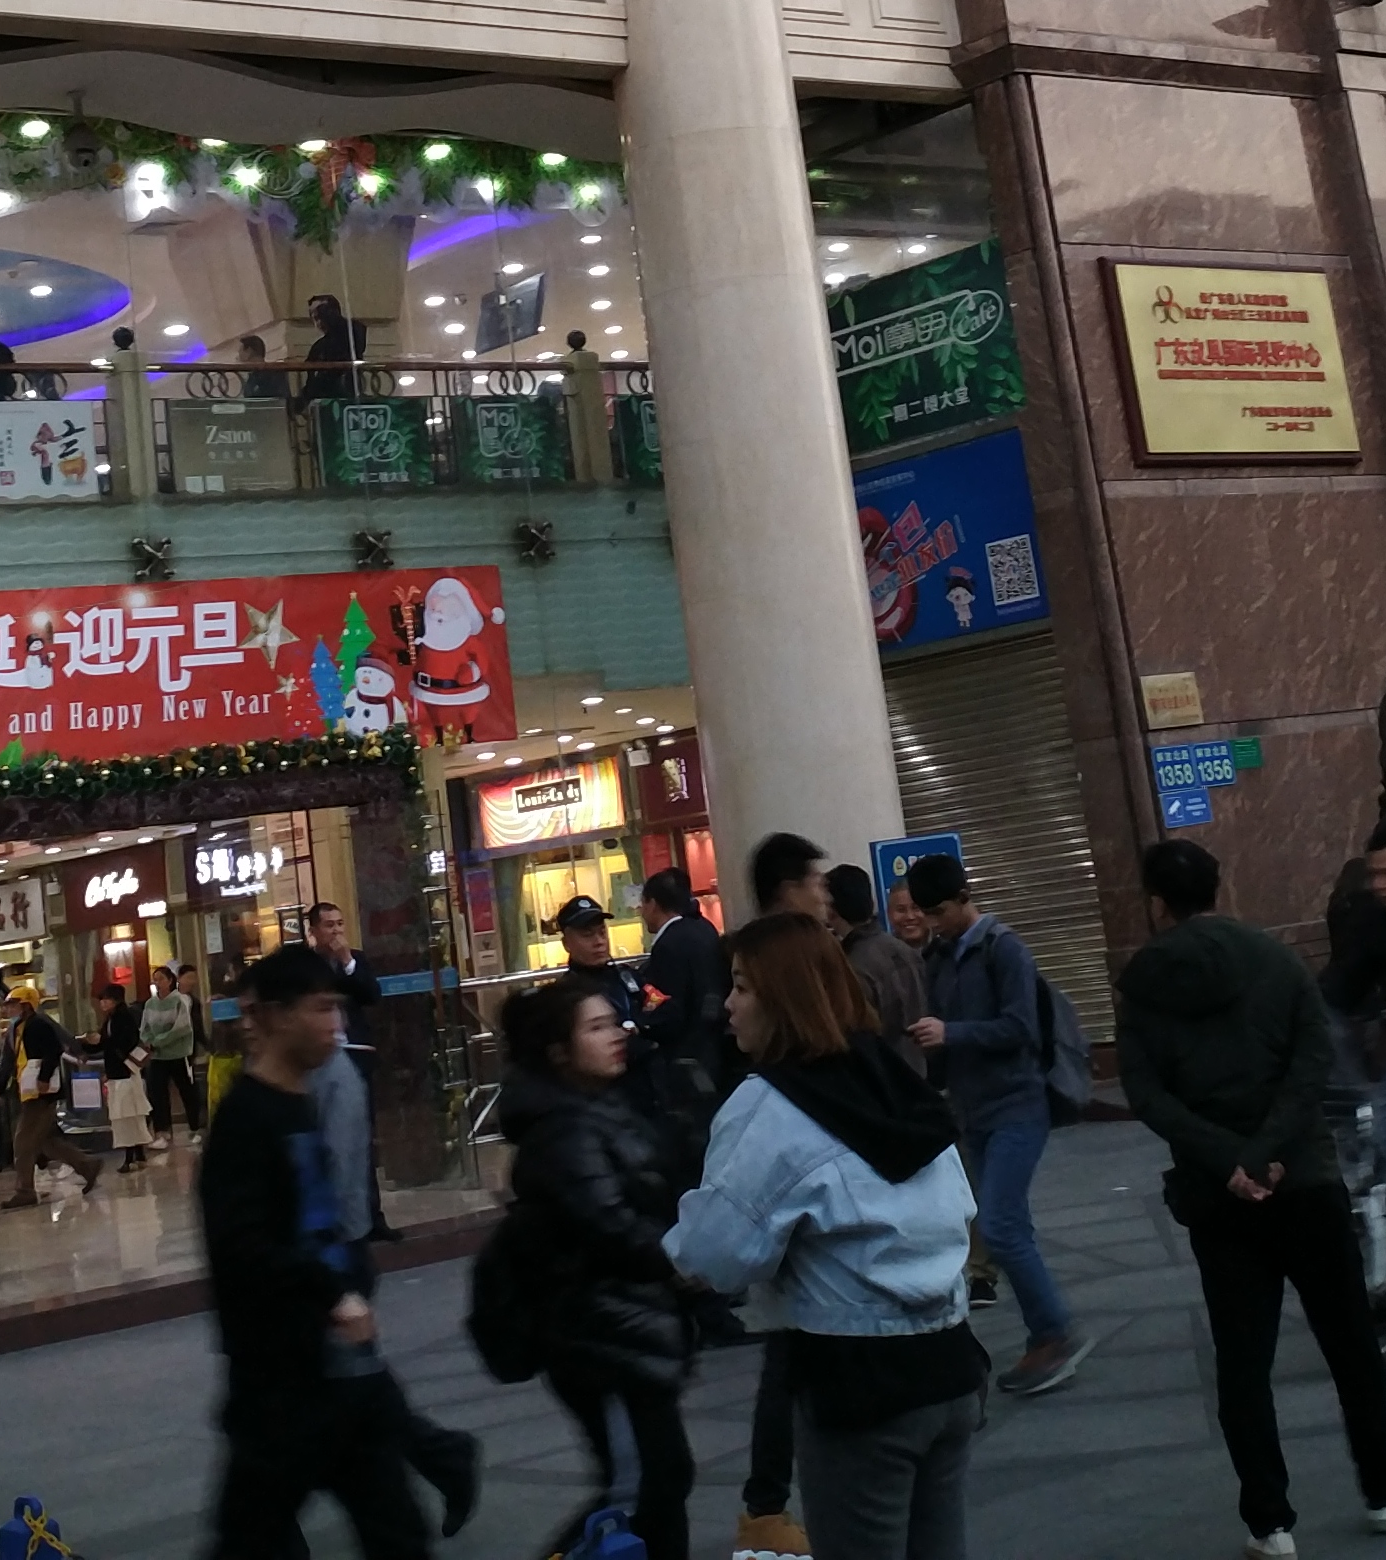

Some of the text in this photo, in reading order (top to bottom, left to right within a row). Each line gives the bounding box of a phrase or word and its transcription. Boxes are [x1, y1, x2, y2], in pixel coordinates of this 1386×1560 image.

[348, 409, 384, 430] Moi
[53, 599, 245, 692] 迎元旦
[8, 703, 53, 737] and
[69, 698, 144, 735] Happy
[161, 693, 208, 723] New
[221, 688, 274, 719] Year
[1158, 762, 1195, 787] 1358
[1197, 757, 1233, 782] 1356
